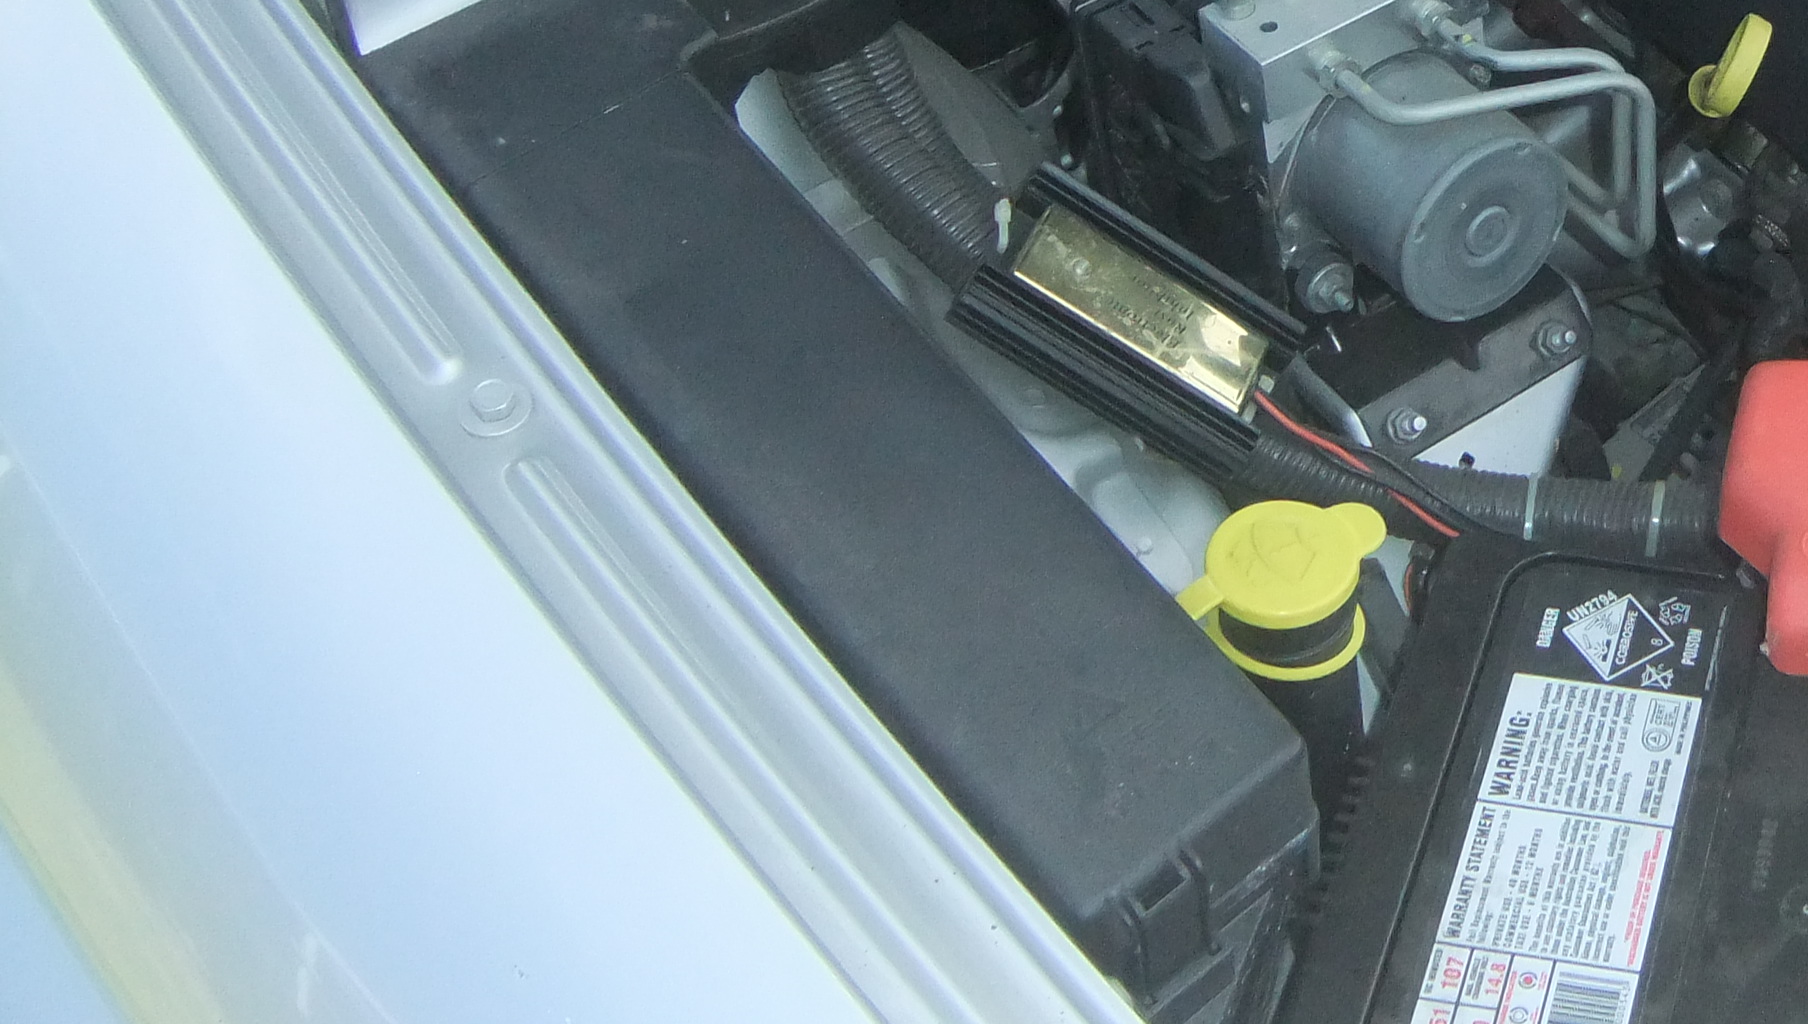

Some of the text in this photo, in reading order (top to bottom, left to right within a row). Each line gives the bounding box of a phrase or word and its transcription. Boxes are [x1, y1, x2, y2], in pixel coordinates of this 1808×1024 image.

[1566, 589, 1618, 623] UN2794
[1535, 607, 1560, 647] DANGER
[1614, 609, 1639, 665] CORROSIVE
[1649, 637, 1664, 646] 8
[1680, 627, 1703, 665] POISON
[1487, 709, 1532, 798] WARNING:
[1444, 874, 1477, 939] WARRANTY
[1464, 805, 1496, 872] STATEMENT
[1438, 955, 1465, 990] 107
[1483, 961, 1506, 996] 14.8
